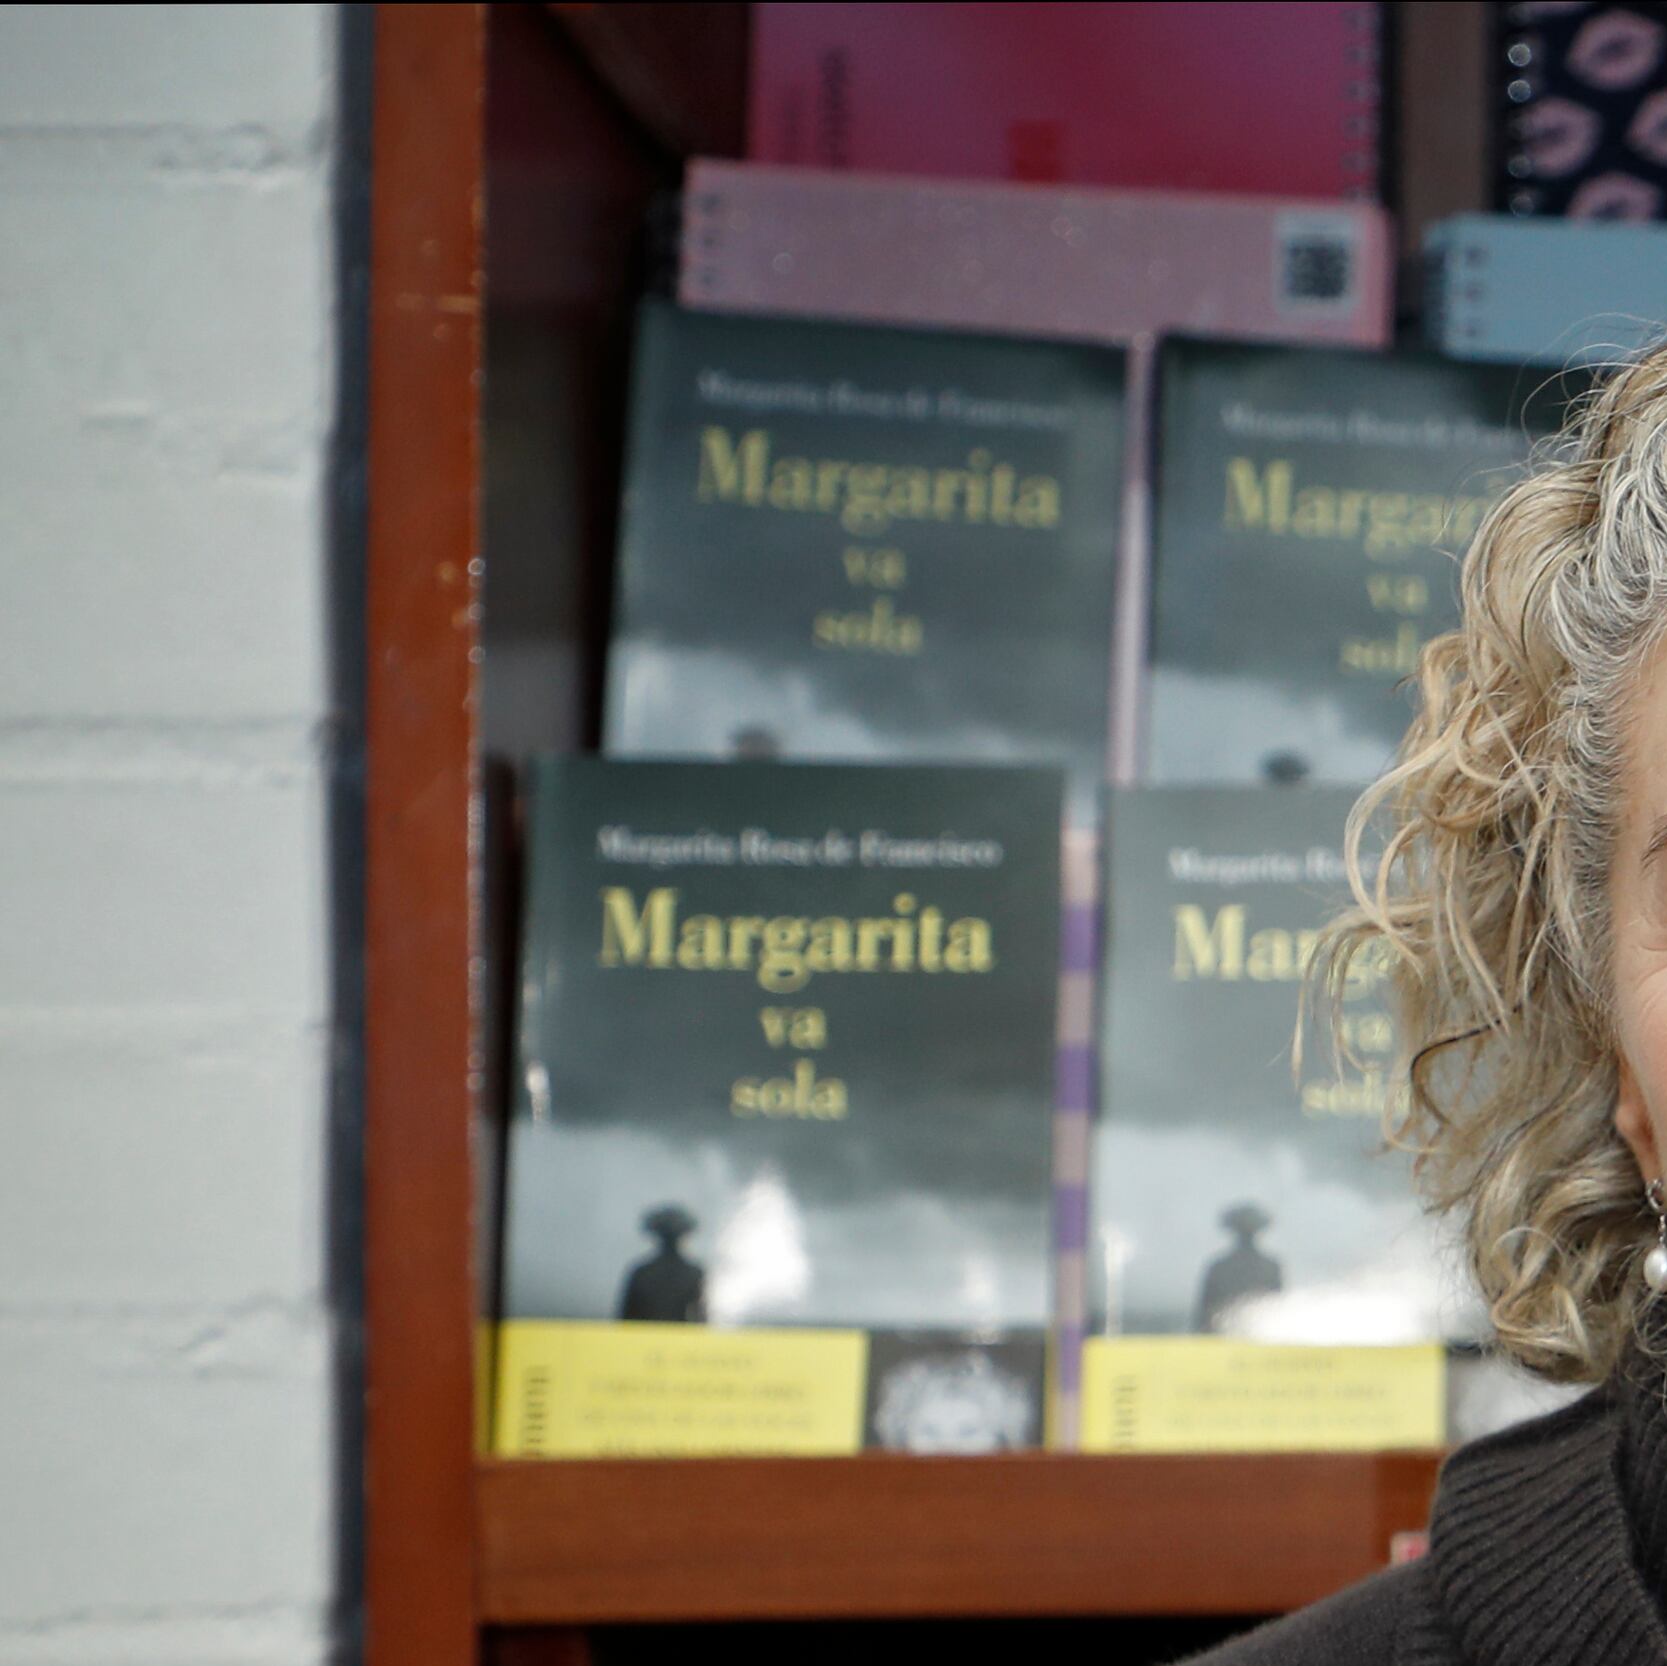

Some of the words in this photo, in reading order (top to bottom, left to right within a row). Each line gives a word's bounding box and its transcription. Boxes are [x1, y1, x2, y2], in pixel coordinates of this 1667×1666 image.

[698, 426, 1061, 535] Margarita
[599, 886, 995, 994] Margarita
[760, 1005, 829, 1050] va
[729, 1057, 848, 1121] sola
